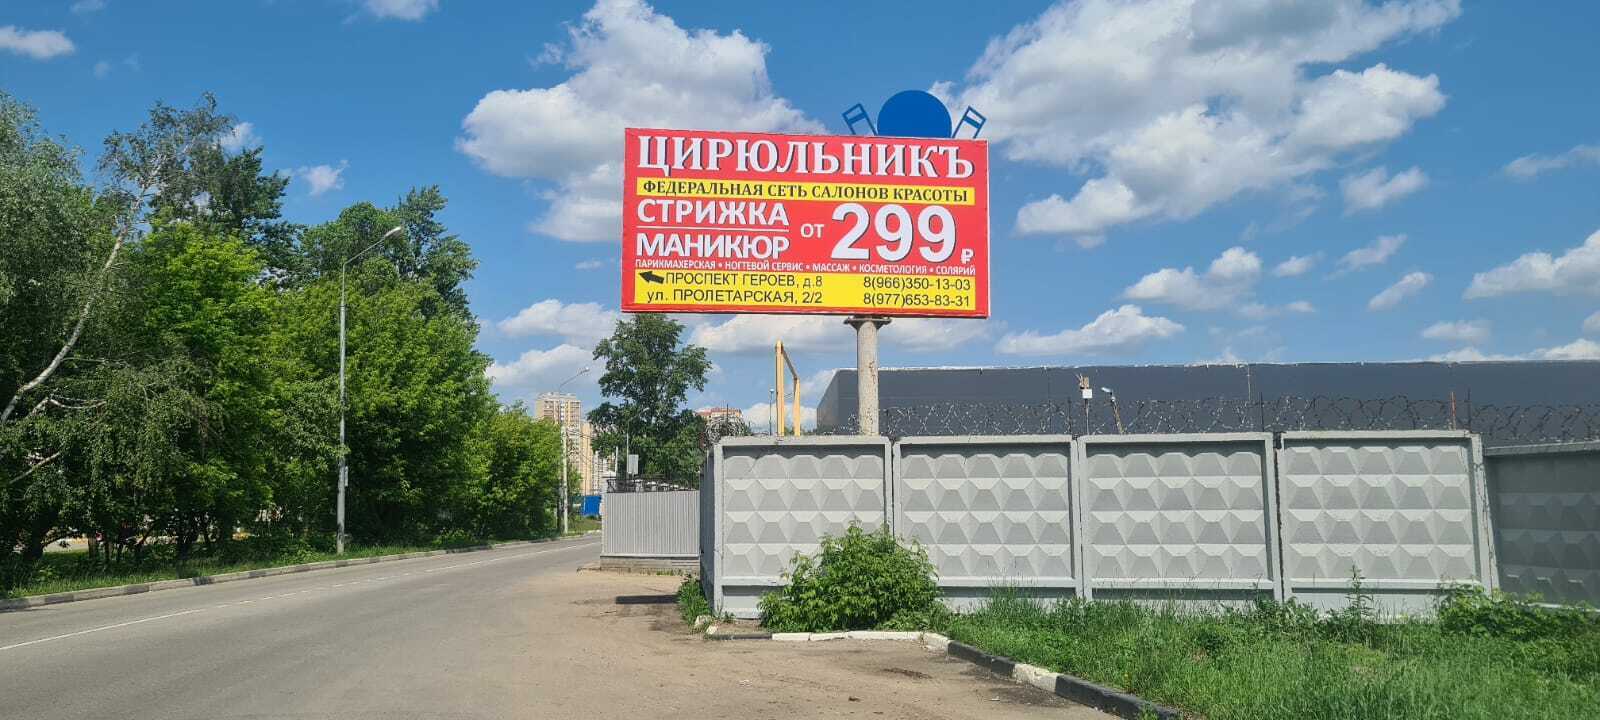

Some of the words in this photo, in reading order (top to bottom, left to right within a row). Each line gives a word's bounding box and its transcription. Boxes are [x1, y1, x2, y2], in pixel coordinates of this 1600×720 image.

[637, 135, 975, 179] ЦИРЮЛЬНИКЪ
[643, 180, 763, 196] ФЕДЕРАЛЬНАЯ
[768, 183, 807, 199] СЕТЬ
[812, 185, 888, 200] САЛОНОВ
[893, 188, 967, 202] КРАСОТЫ
[637, 199, 789, 225] СТРИЖКА
[831, 203, 957, 263] 299
[636, 233, 790, 259] МАНИКЮР
[635, 259, 716, 269] ПАРИКМАХЕРСКАЯ
[725, 261, 770, 271] НОГТЕВОЙ
[771, 262, 803, 271] СЕРВИС
[812, 263, 850, 272] МАССАЖ
[859, 264, 927, 274] КОСМЕТОЛОГИЯ
[936, 265, 975, 275] СОЛЯРИЙ
[665, 272, 739, 286] ПРОСПЕКТ
[742, 274, 800, 289] ГЕРОЕВ,
[864, 277, 971, 291] 8(966)350-13-03
[647, 292, 668, 303] ул.
[673, 289, 798, 305] ПРОЛЕТАРСКАЯ,
[802, 291, 823, 304] 2/2
[864, 293, 970, 306] 8(977)653-83-31
